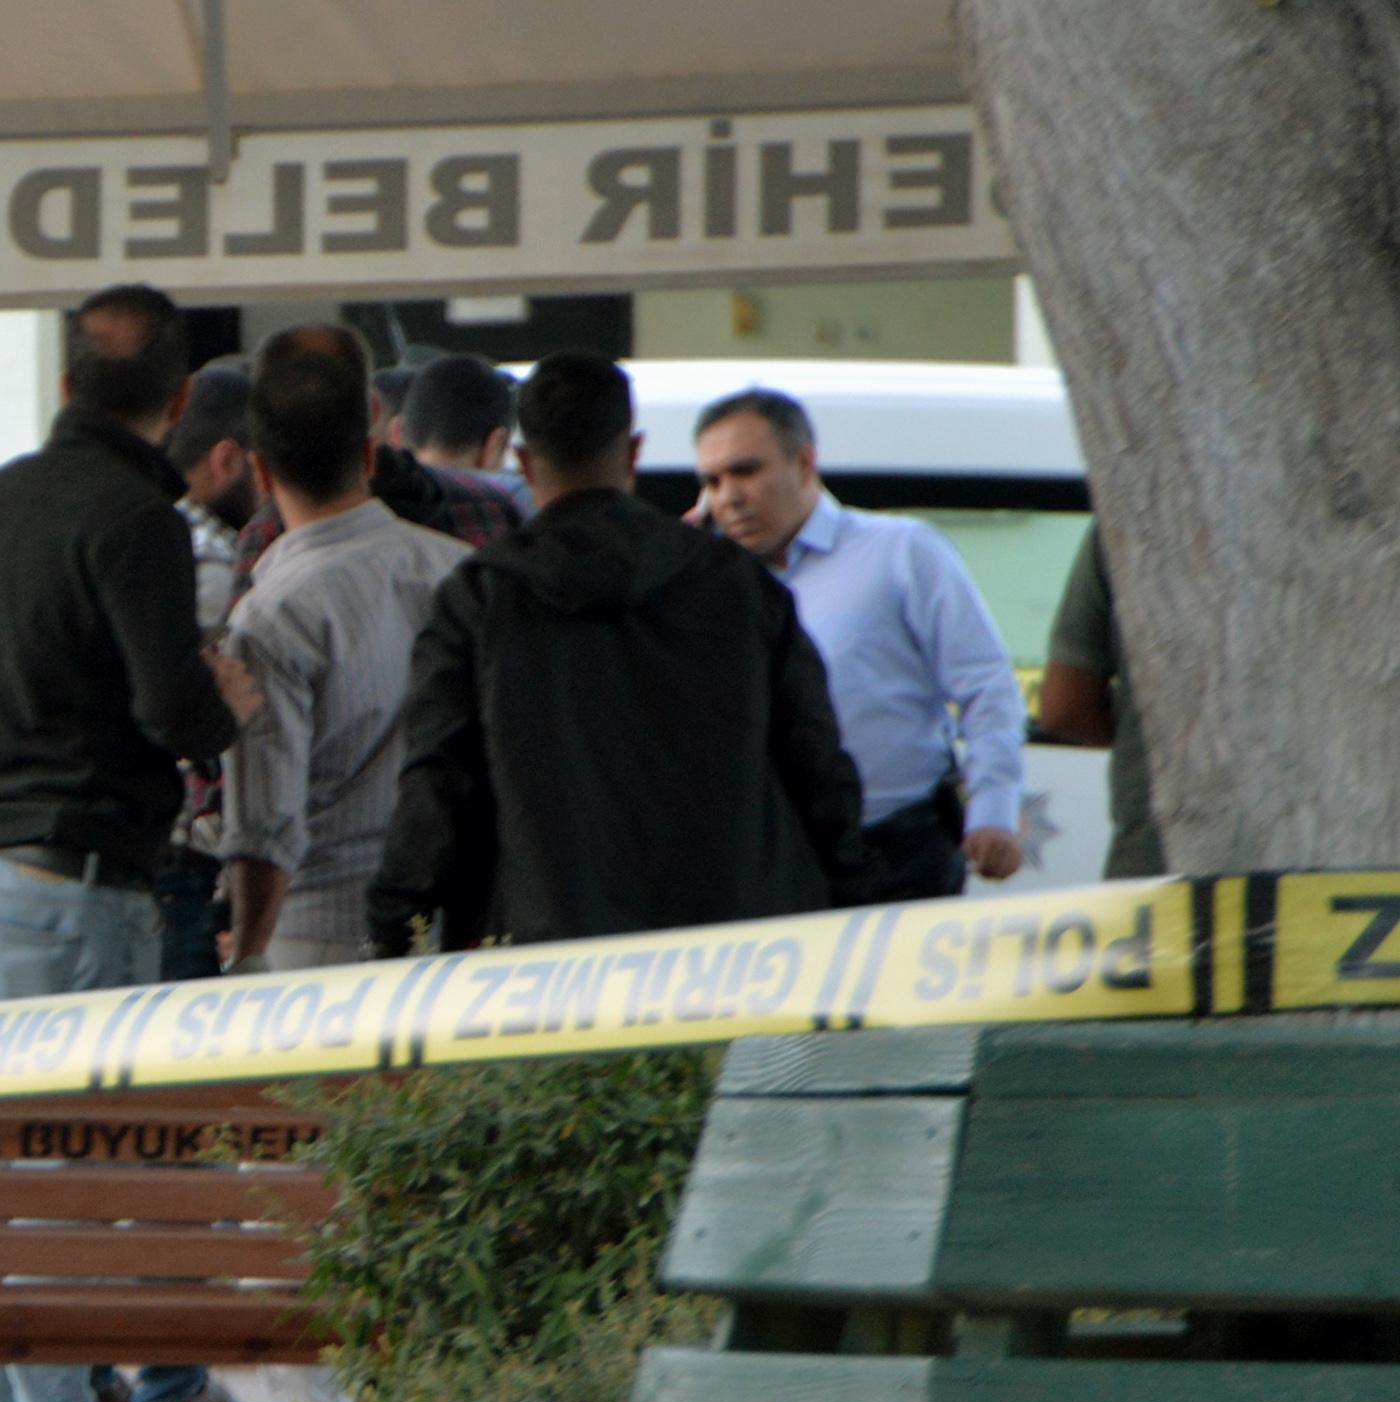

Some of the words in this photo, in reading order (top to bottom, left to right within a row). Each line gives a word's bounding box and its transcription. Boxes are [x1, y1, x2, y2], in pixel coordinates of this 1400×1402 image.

[454, 936, 802, 1039] GİRİLMEZ
[914, 902, 1152, 1000] POLİS
[171, 976, 379, 1060] POLİS
